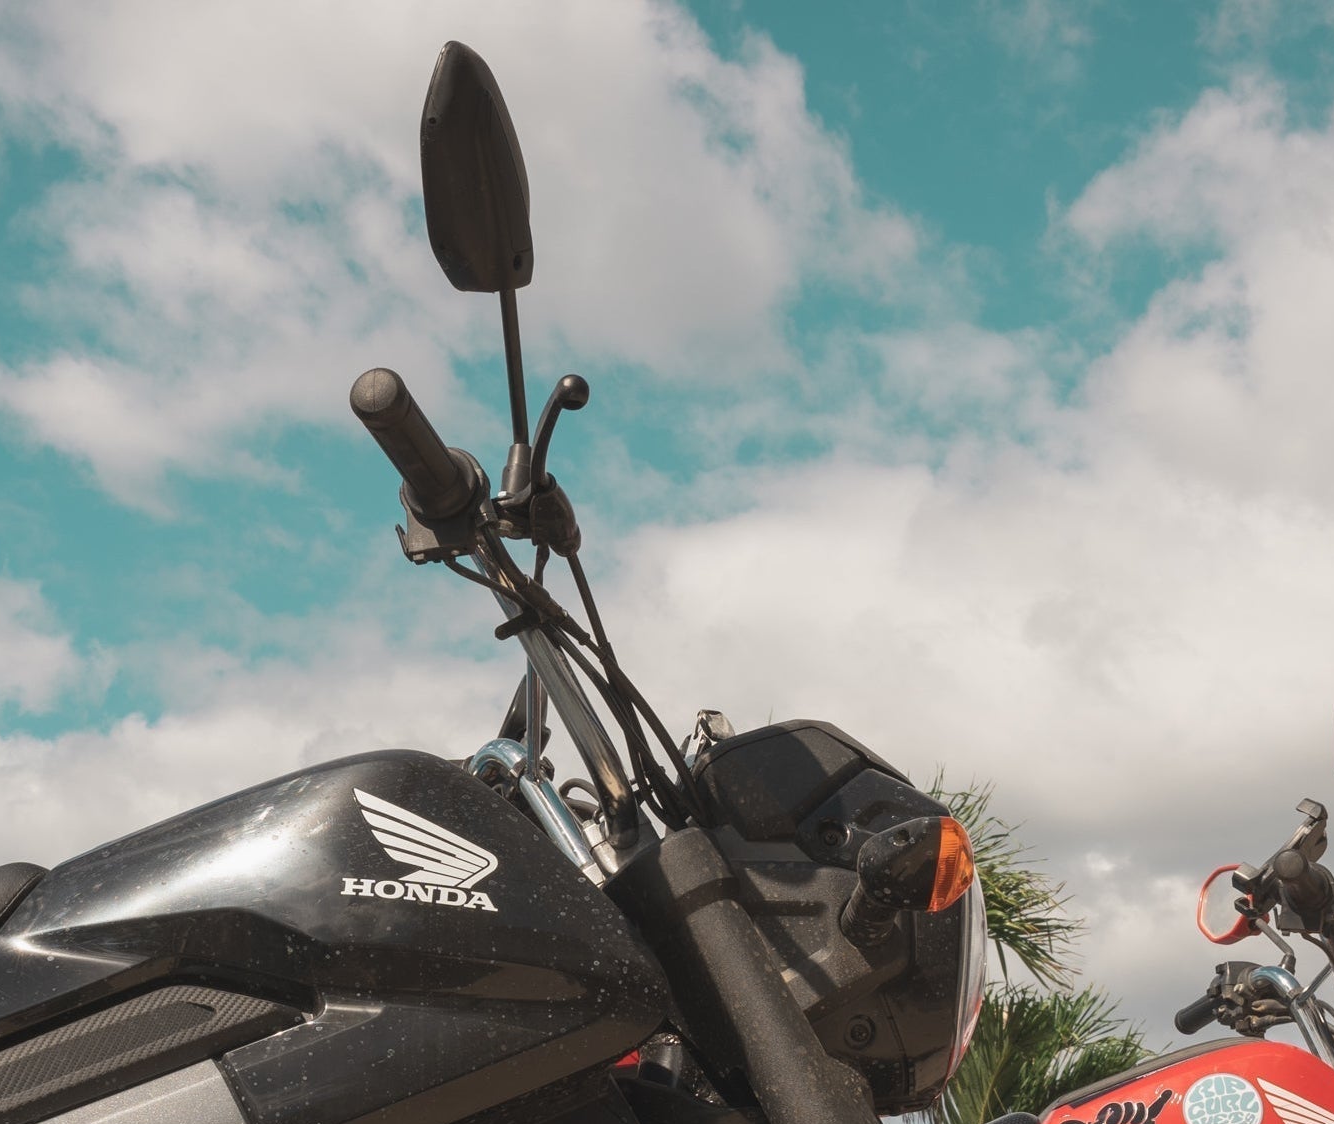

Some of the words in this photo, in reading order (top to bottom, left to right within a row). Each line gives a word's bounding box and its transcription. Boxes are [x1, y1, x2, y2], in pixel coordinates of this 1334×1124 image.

[340, 877, 499, 912] HONDA
[1189, 1076, 1247, 1103] RIP
[1187, 1091, 1259, 1120] CURL
